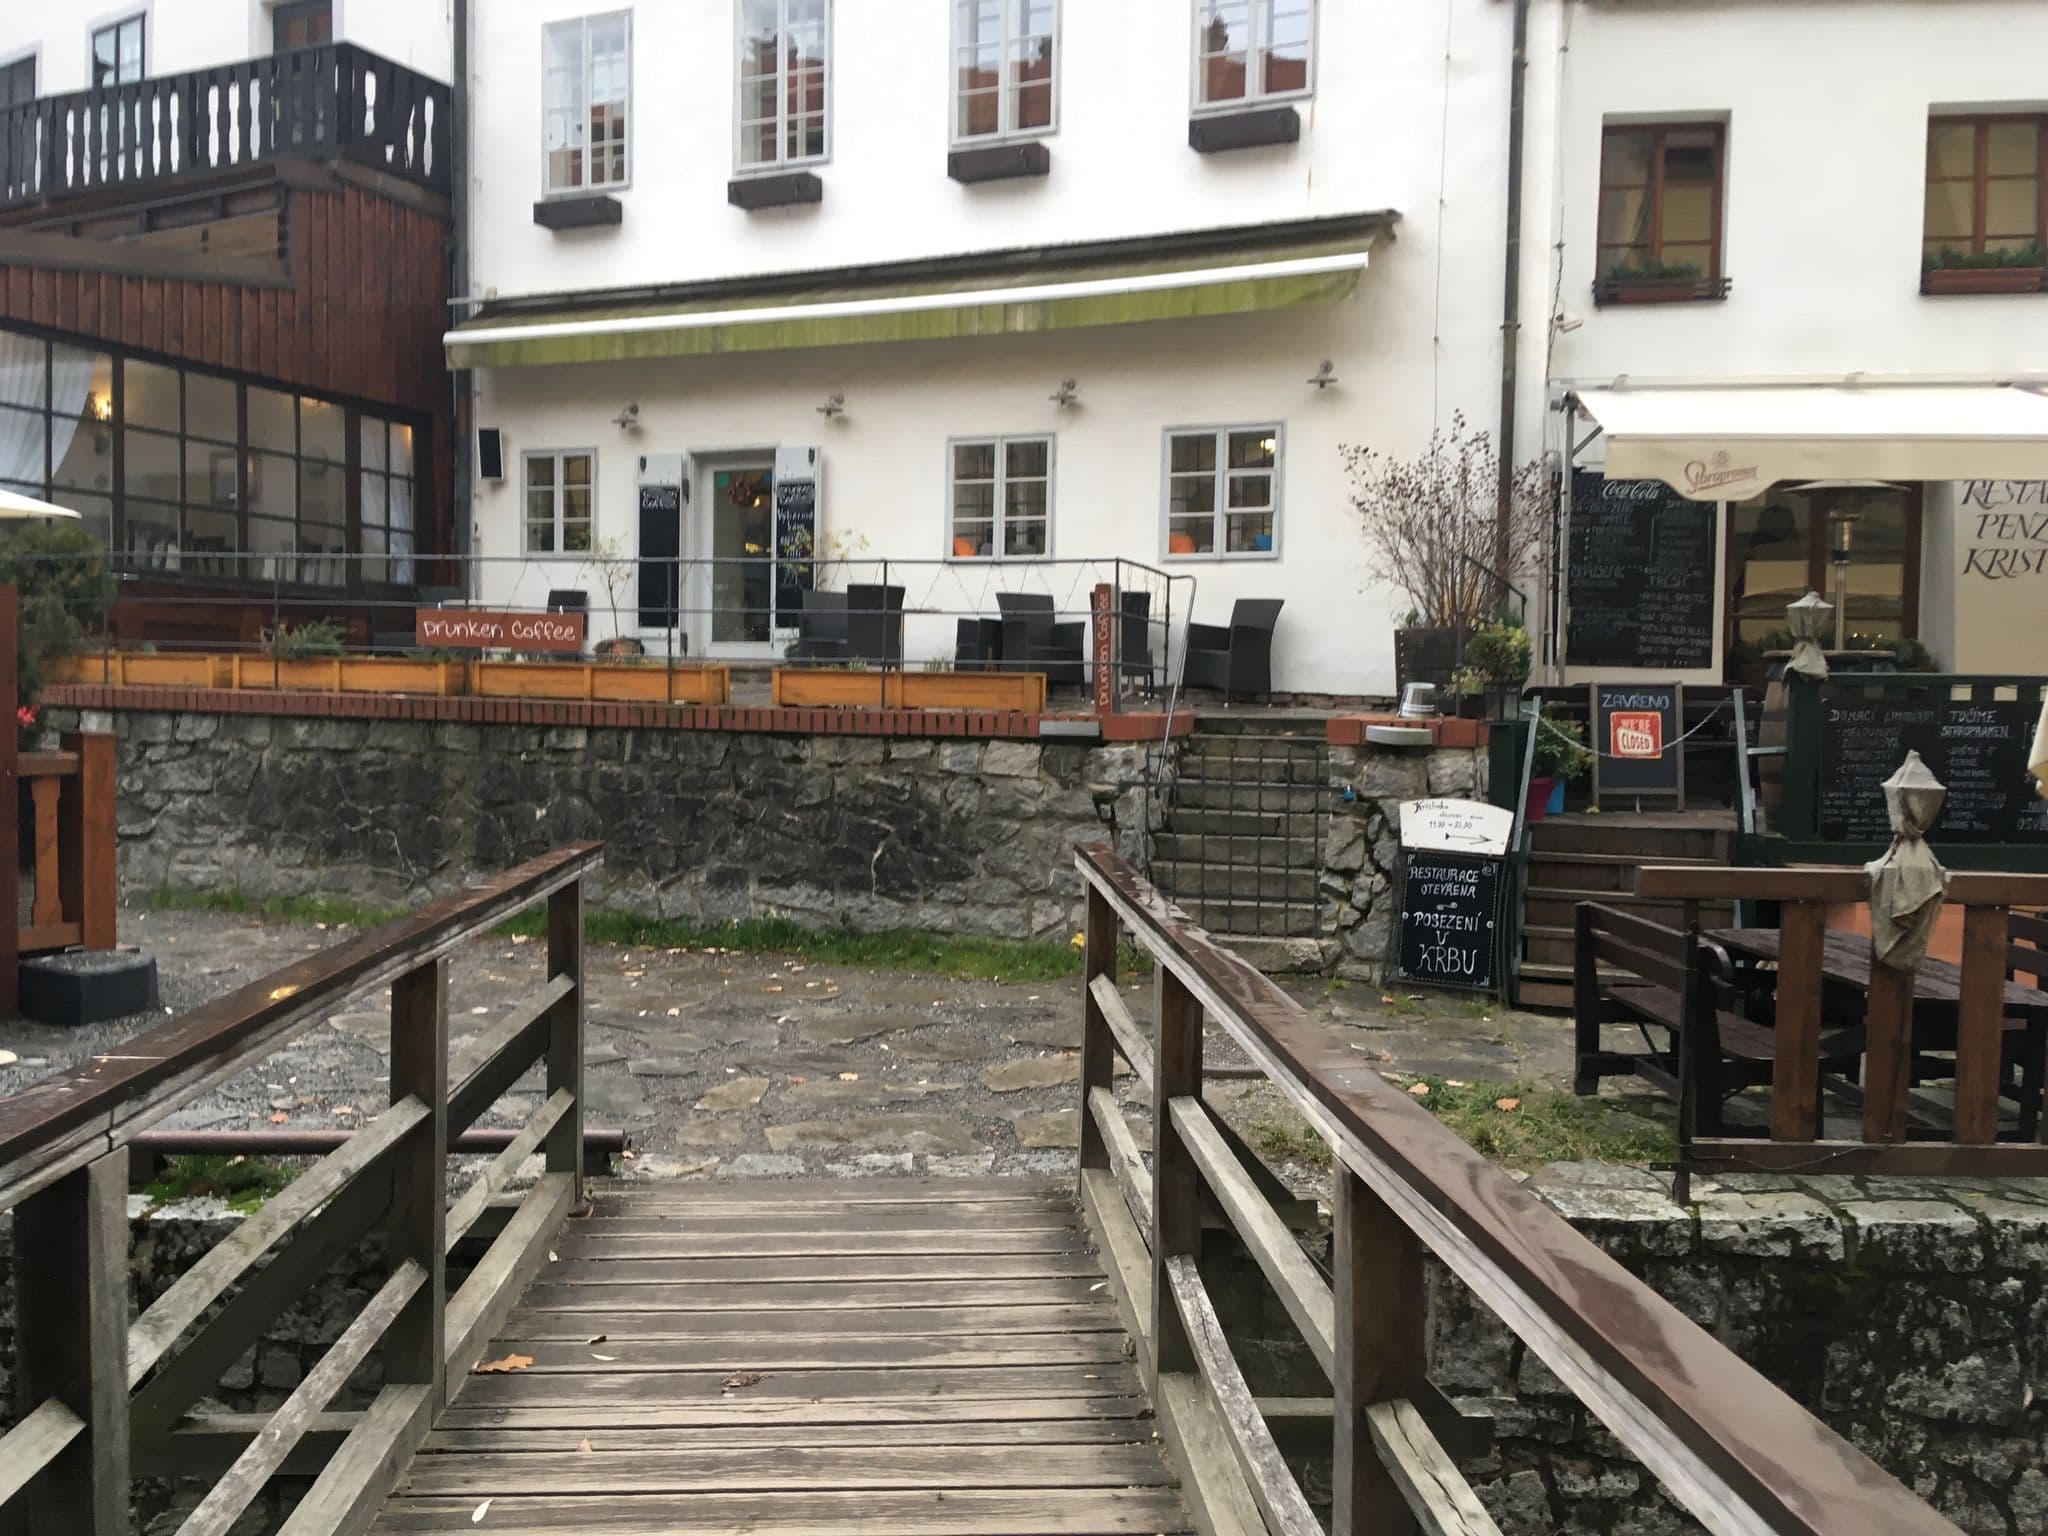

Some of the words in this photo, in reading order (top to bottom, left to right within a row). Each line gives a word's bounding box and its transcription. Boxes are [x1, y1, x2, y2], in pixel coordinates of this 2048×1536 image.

[1097, 592, 1109, 640] Coffee
[423, 619, 504, 639] Drunken
[511, 620, 575, 642] Coffee
[1098, 645, 1109, 706] Drunken
[1621, 732, 1650, 750] CLOSED
[1408, 866, 1480, 883] RESTAURACE
[1413, 911, 1482, 932] POSEZENÍ
[1417, 944, 1477, 975] KRBU
